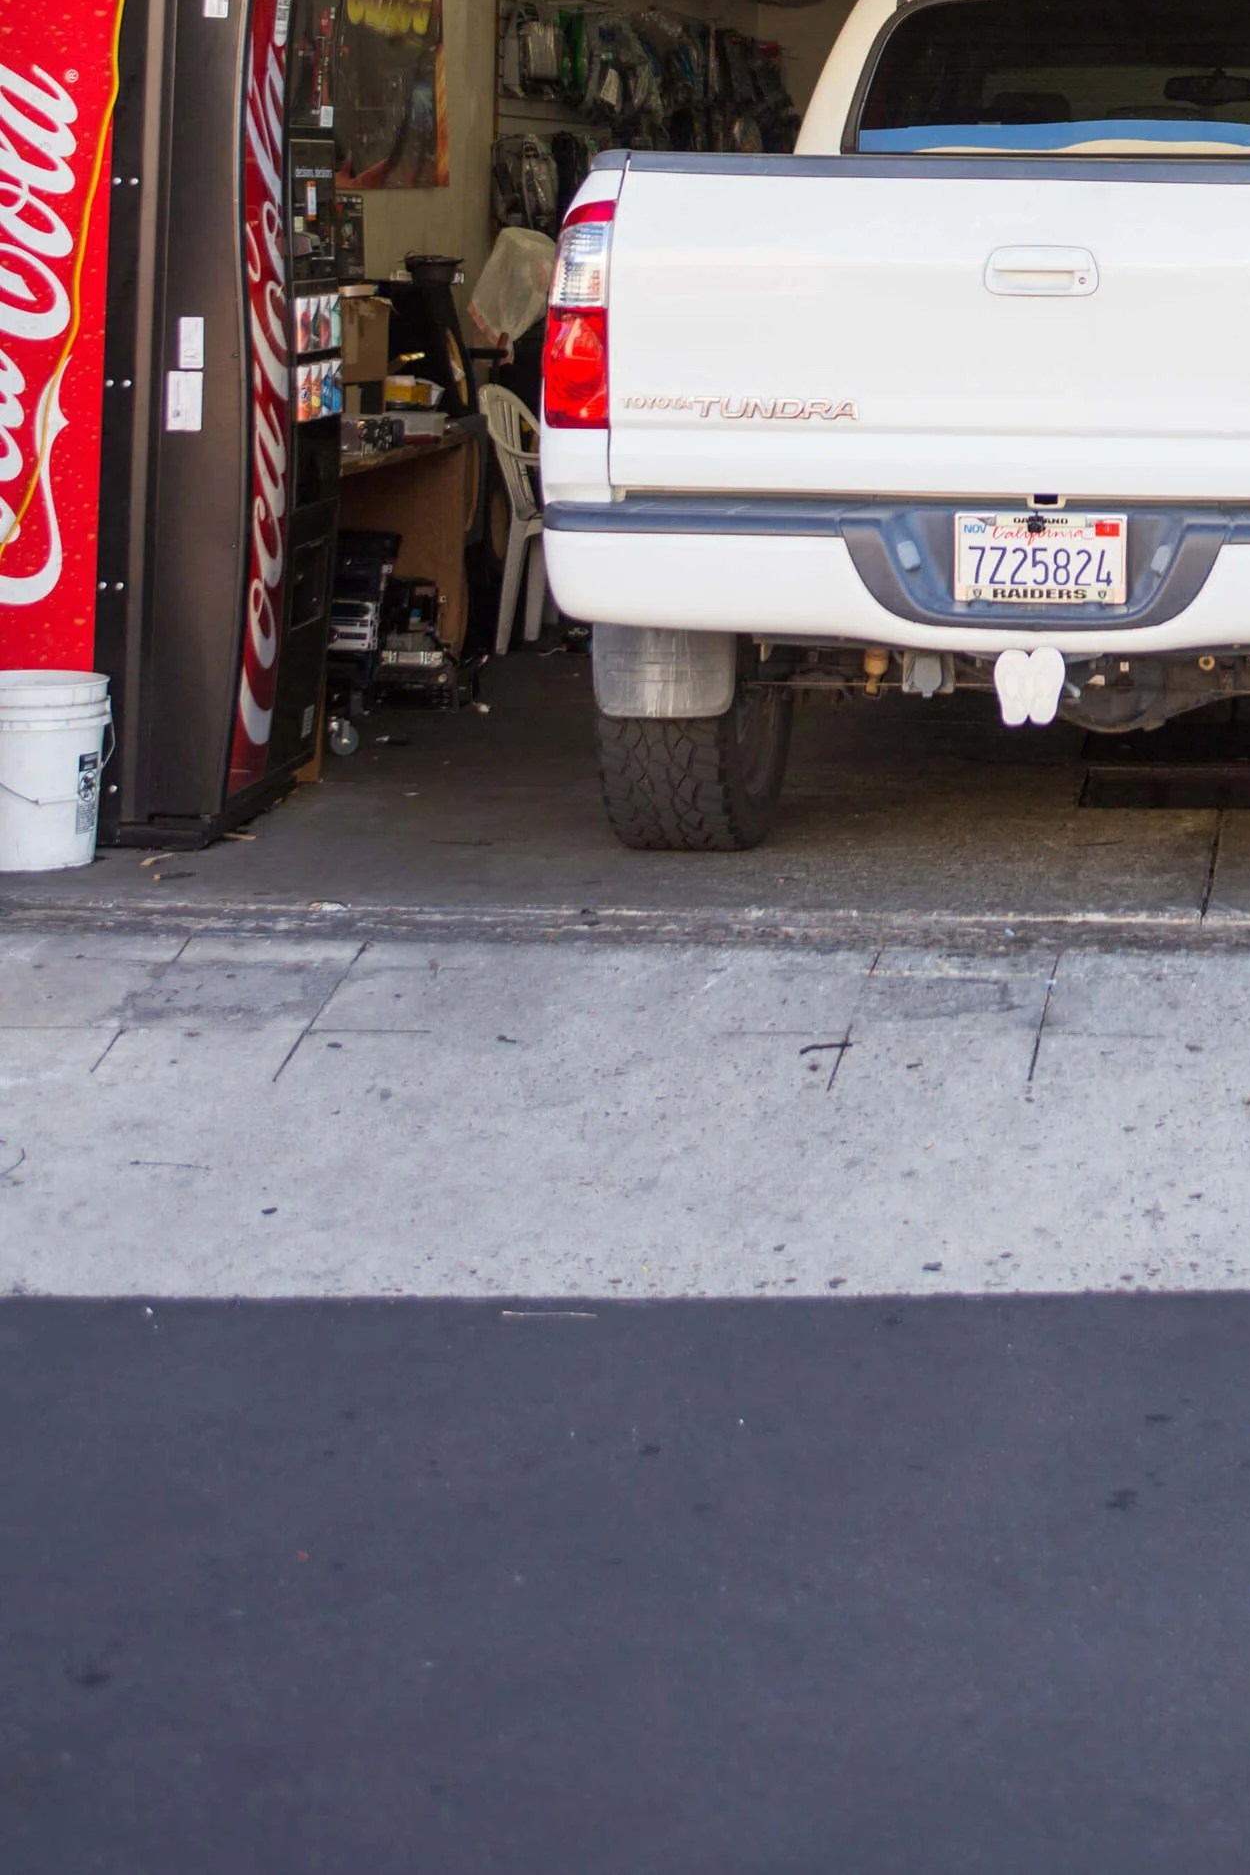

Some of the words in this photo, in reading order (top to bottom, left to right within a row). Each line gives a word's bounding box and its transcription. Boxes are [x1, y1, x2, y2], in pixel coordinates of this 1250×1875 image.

[621, 396, 694, 409] TOYOTA
[694, 396, 859, 421] TUNDRA
[1013, 517, 1068, 525] OAAND
[963, 524, 988, 534] NOV
[968, 545, 1113, 587] 7Z25824
[992, 588, 1088, 600] RAIDERS
